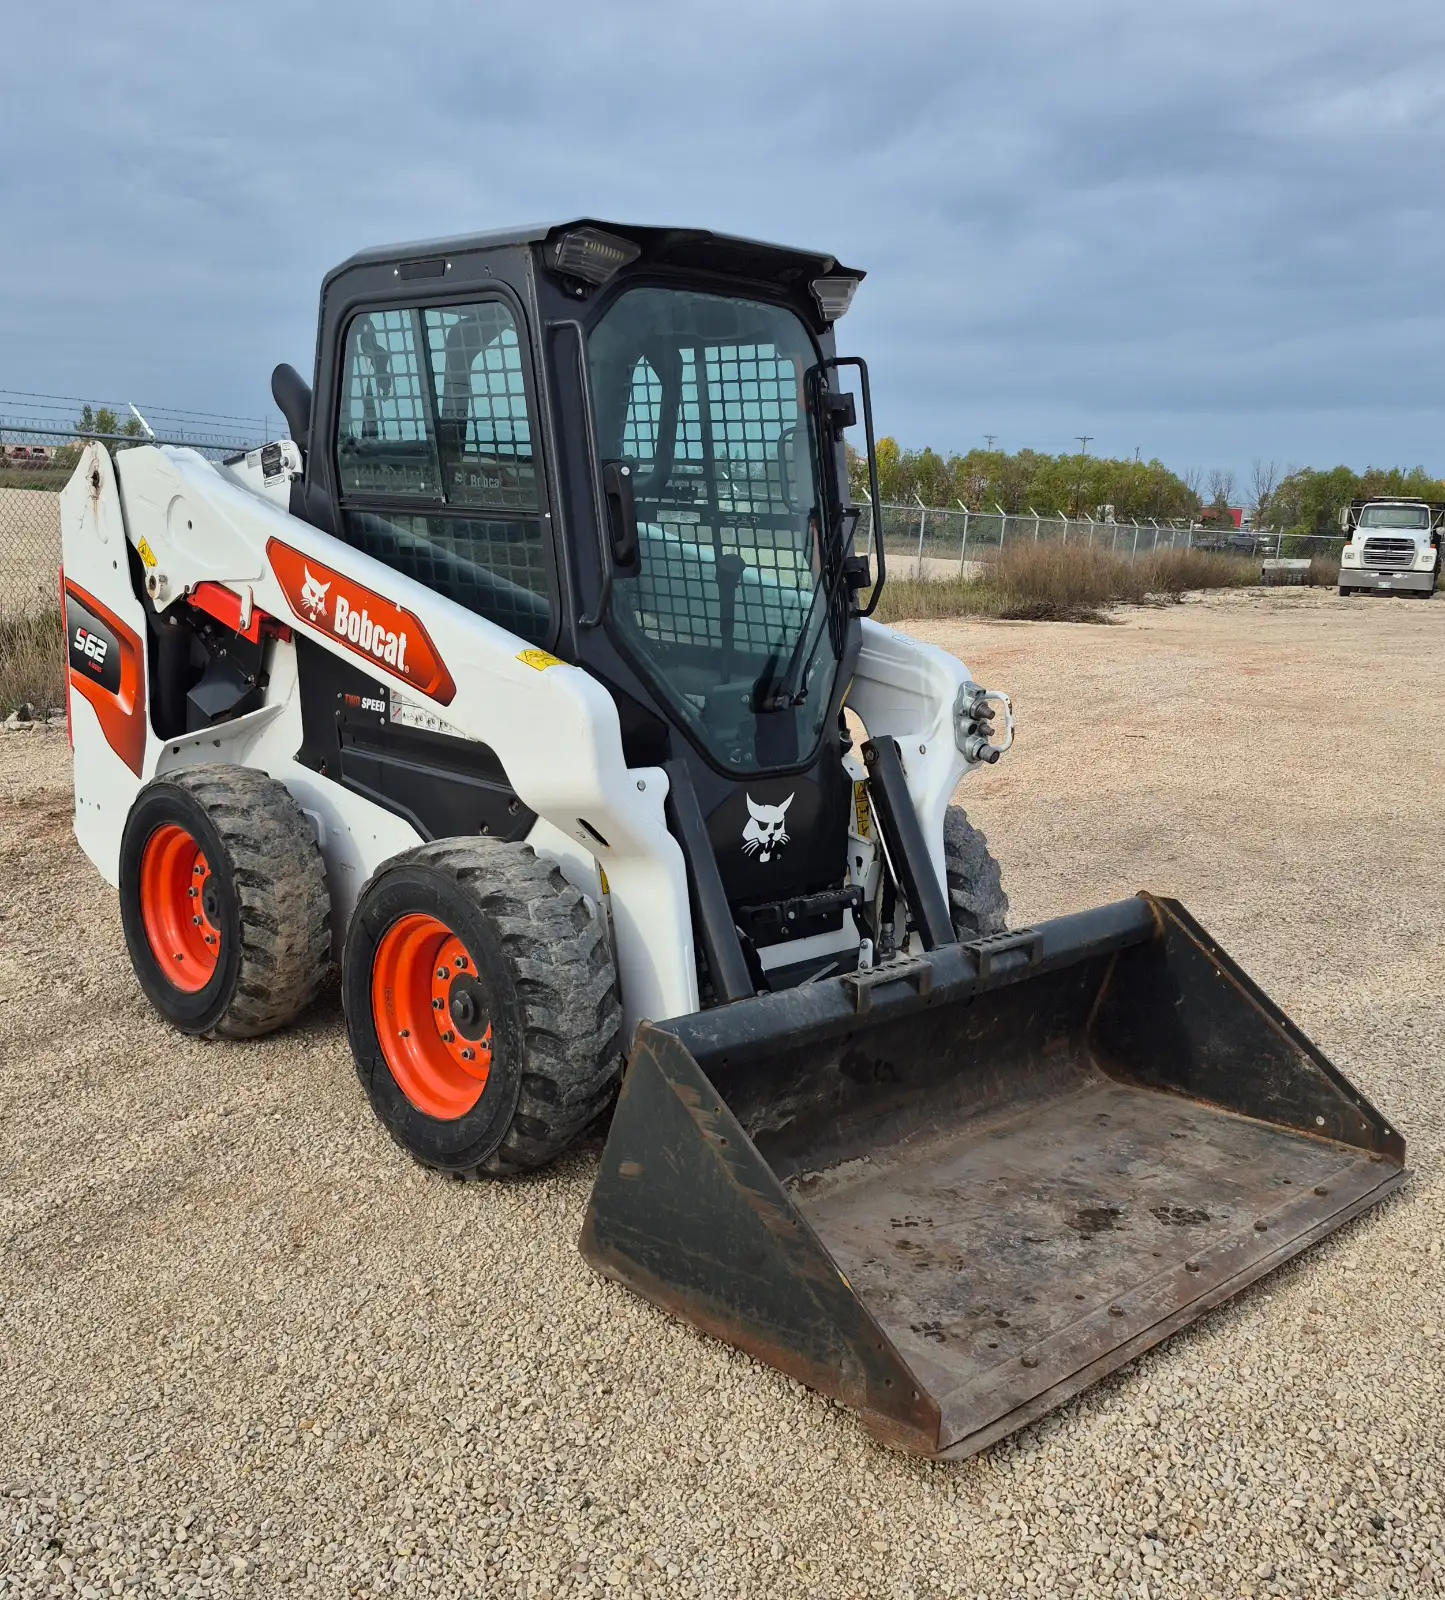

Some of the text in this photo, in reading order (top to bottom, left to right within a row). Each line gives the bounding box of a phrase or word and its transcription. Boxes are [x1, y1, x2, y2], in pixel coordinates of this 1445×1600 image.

[74, 627, 108, 664] S62
[334, 594, 407, 672] Bobcat
[345, 694, 386, 713] TWO SPEED
